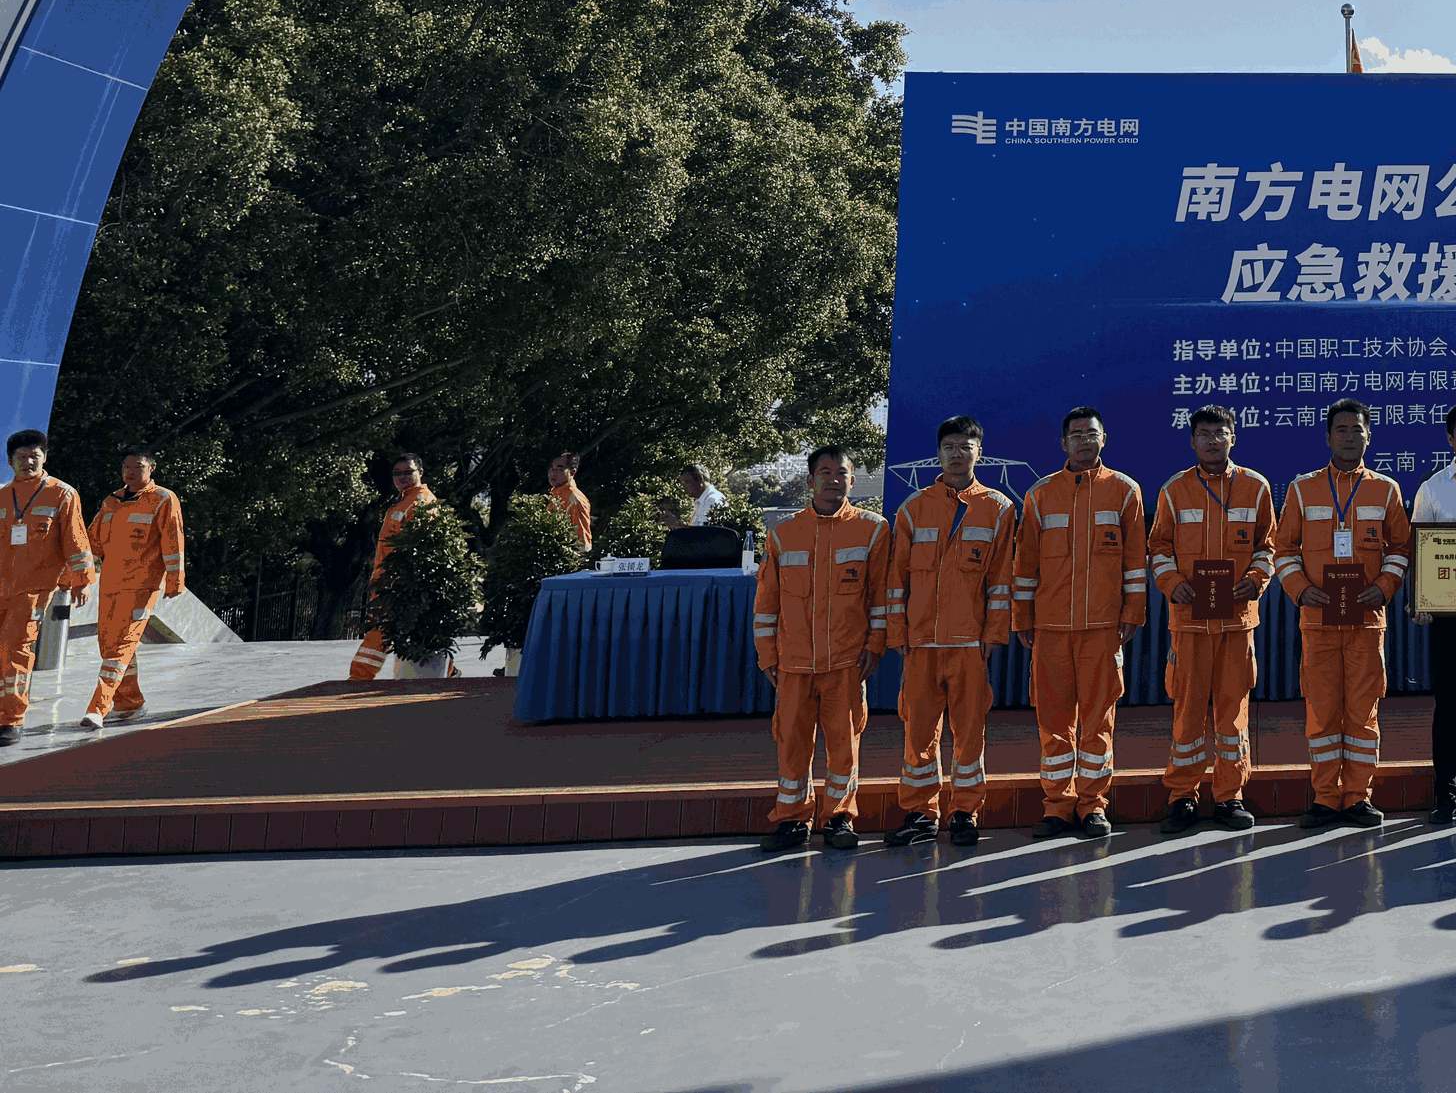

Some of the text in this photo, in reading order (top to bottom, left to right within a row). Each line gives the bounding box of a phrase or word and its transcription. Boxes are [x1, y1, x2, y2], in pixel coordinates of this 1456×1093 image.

[1005, 118, 1139, 136] 中国南方电网
